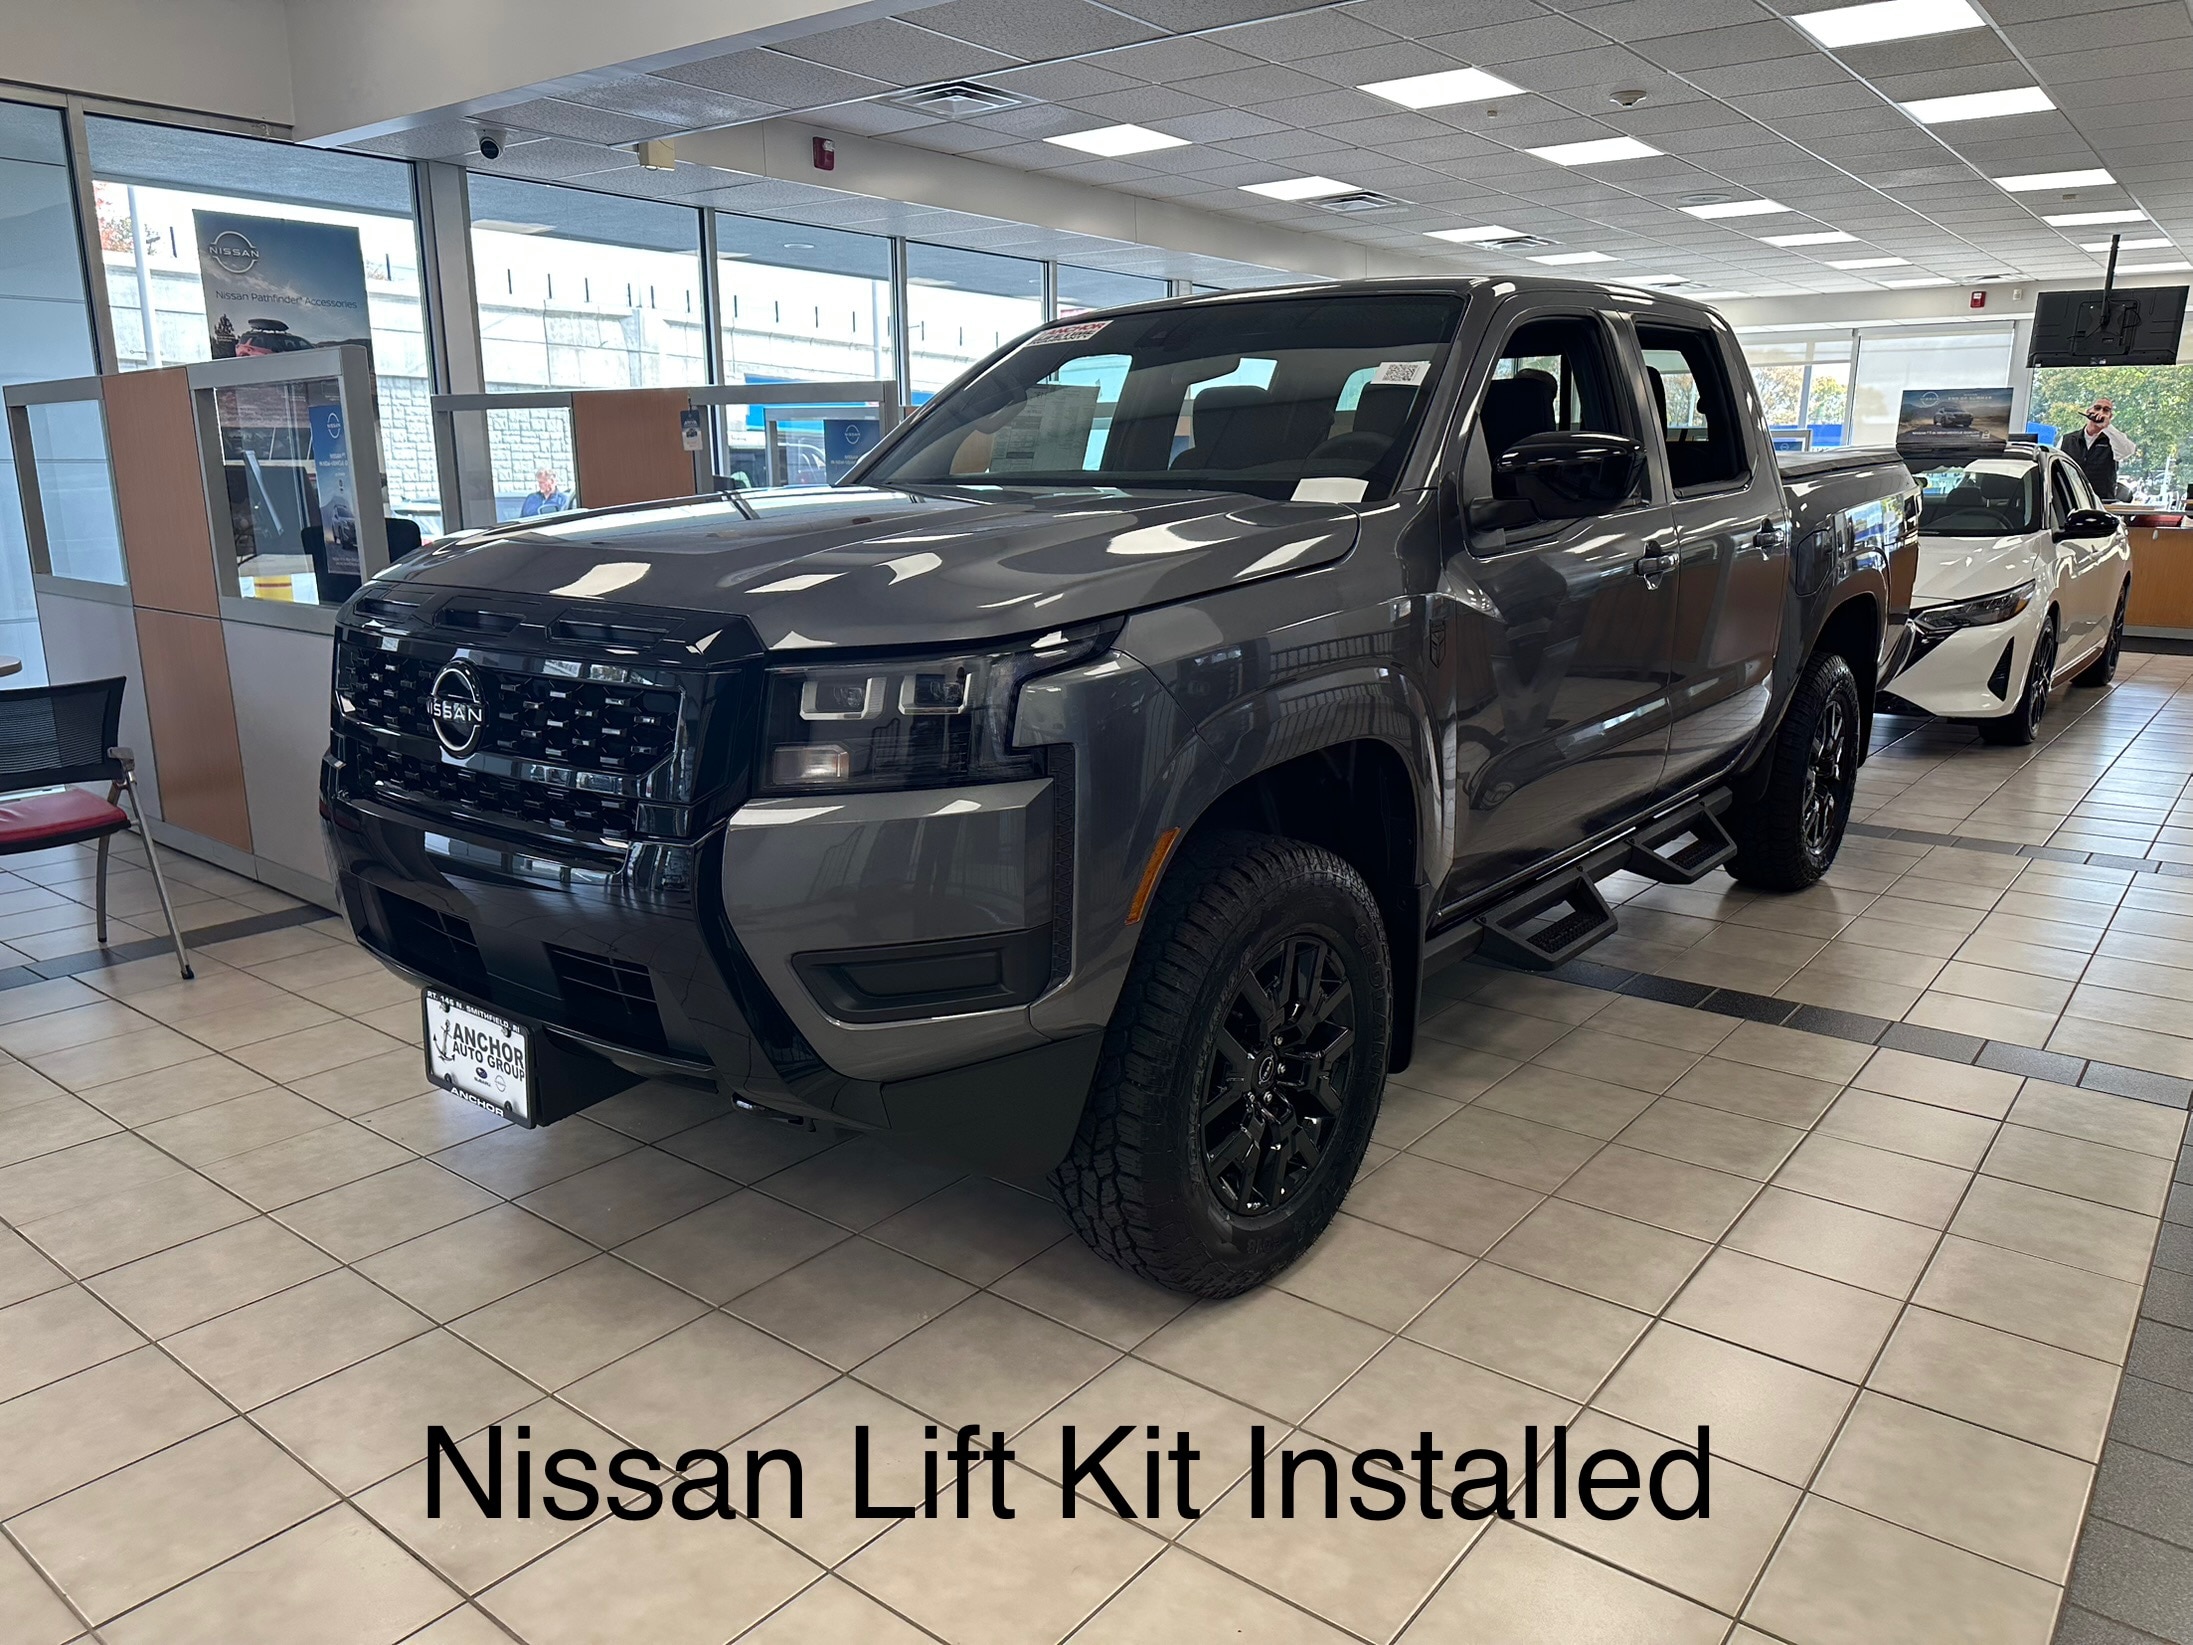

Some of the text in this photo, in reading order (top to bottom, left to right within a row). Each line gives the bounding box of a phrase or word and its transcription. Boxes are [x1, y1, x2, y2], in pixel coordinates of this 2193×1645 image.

[209, 246, 260, 258] NISSAN
[216, 290, 249, 301] Nissan
[305, 297, 358, 309] Accessories
[452, 1022, 525, 1070] ANCHOR
[452, 1041, 525, 1082] AUTO GROUP
[450, 1086, 504, 1118] ANCHOR
